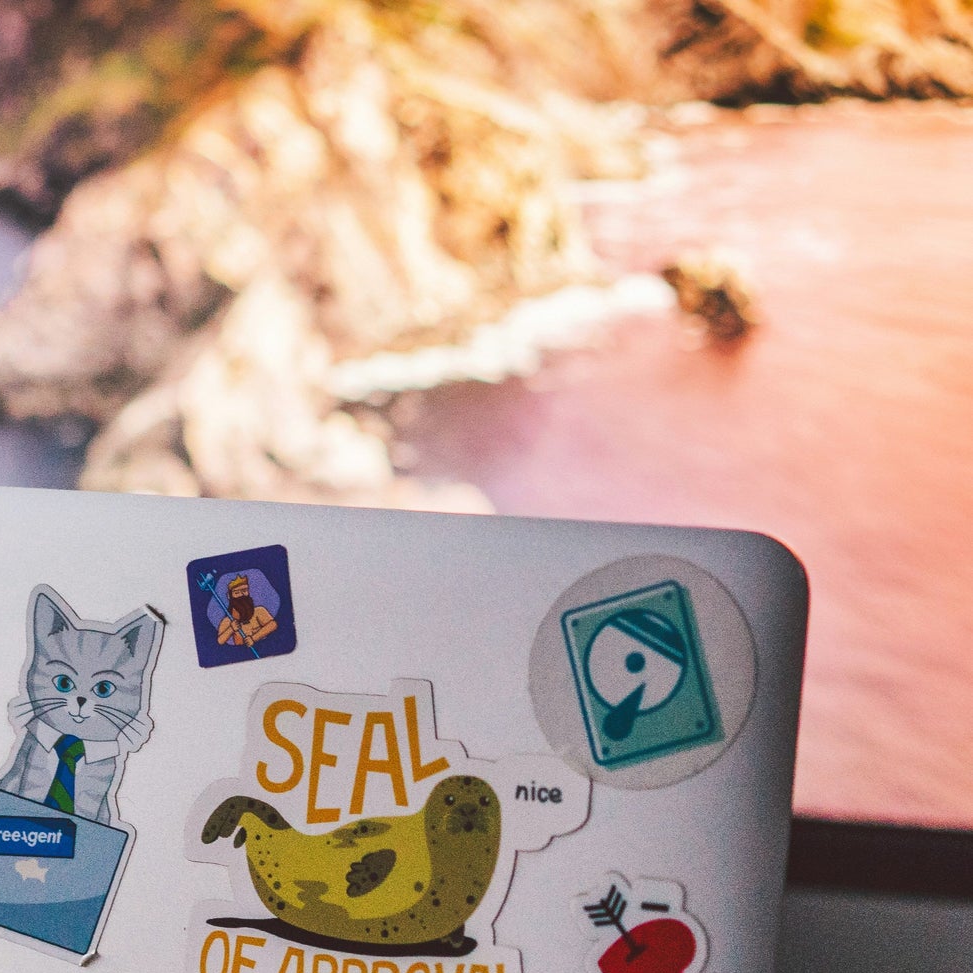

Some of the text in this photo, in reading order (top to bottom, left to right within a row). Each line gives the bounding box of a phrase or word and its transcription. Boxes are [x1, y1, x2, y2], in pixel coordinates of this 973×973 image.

[256, 695, 450, 825] SEAL
[515, 781, 563, 804] nice
[640, 901, 671, 913] I
